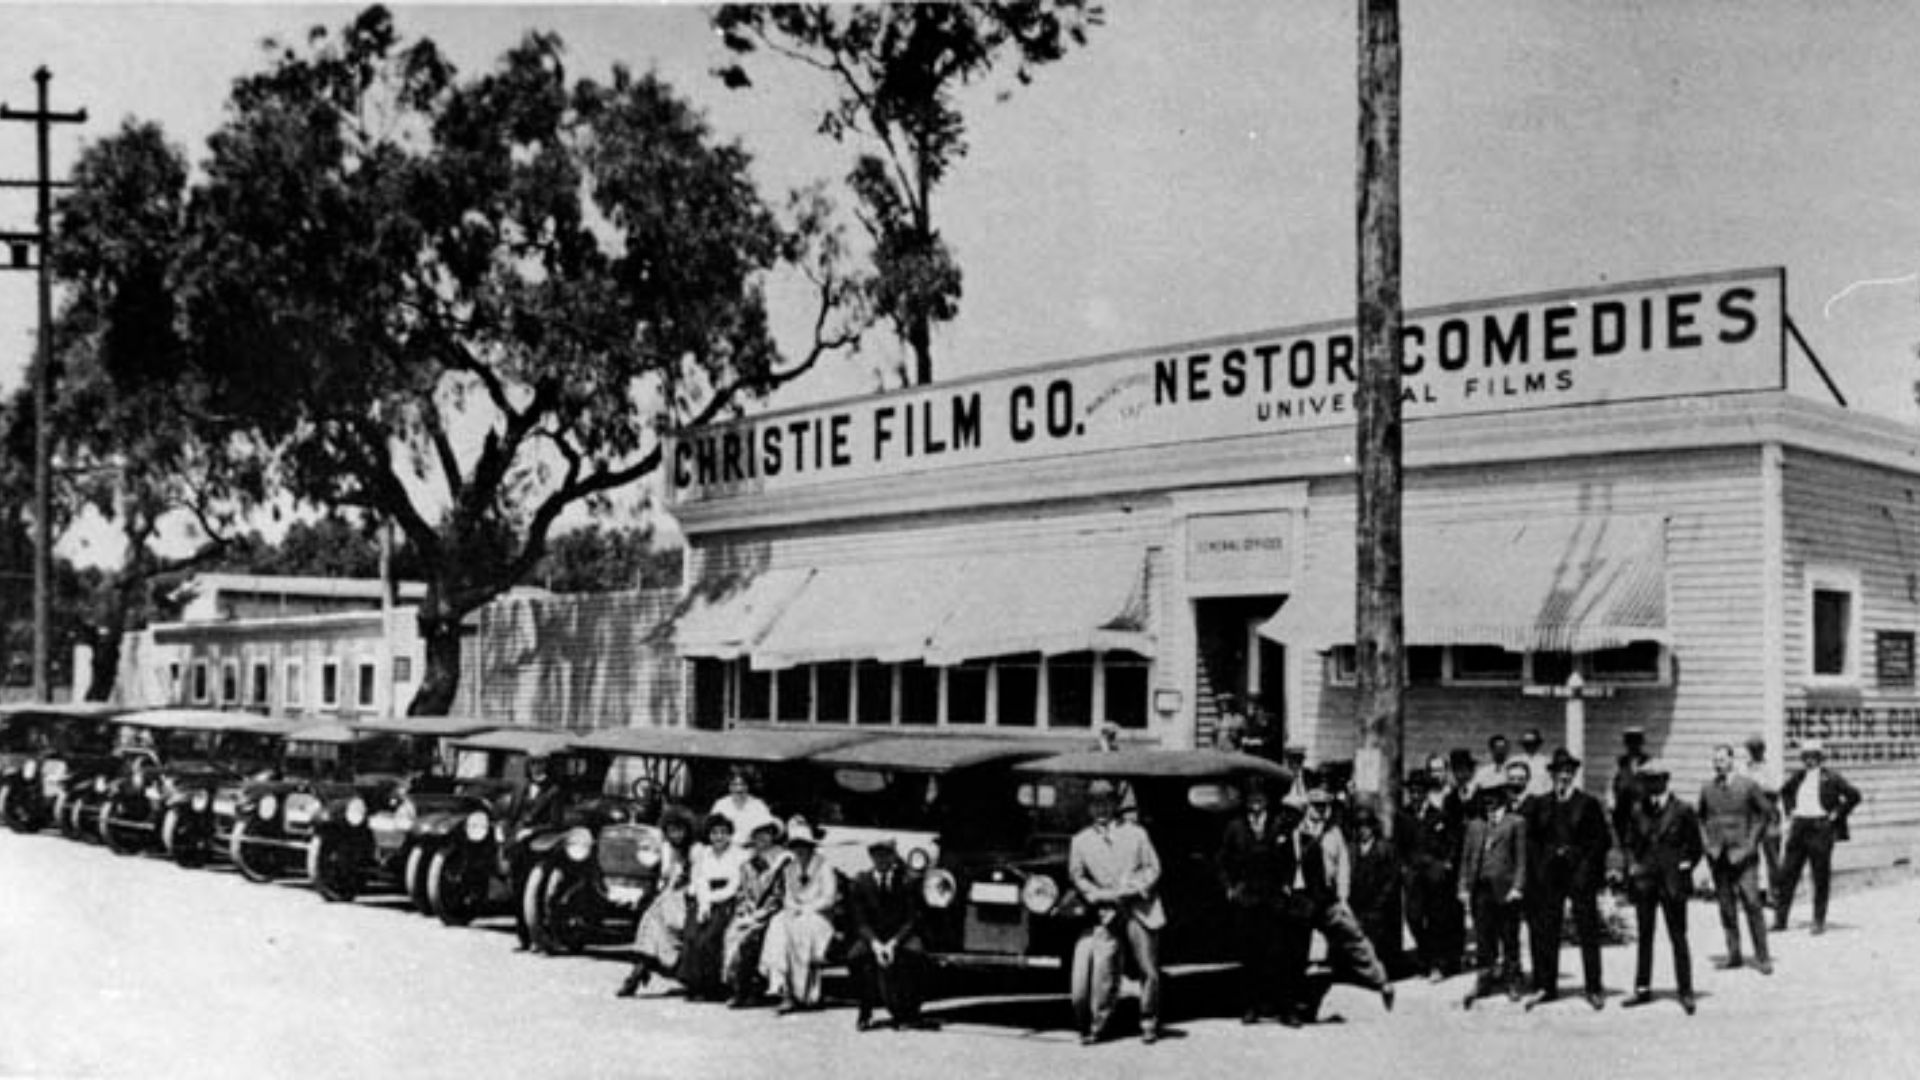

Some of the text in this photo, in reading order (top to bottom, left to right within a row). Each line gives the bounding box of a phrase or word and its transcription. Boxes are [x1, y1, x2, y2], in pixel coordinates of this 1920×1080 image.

[1154, 335, 1357, 407] NESTOR
[1399, 286, 1758, 376] COMEDIES
[673, 414, 851, 489] CHRISTIE
[873, 391, 982, 462] FILM
[1009, 379, 1085, 443] CO.
[1257, 369, 1574, 423] UNIVEAL FILMS
[1784, 706, 1874, 739] NESTOR
